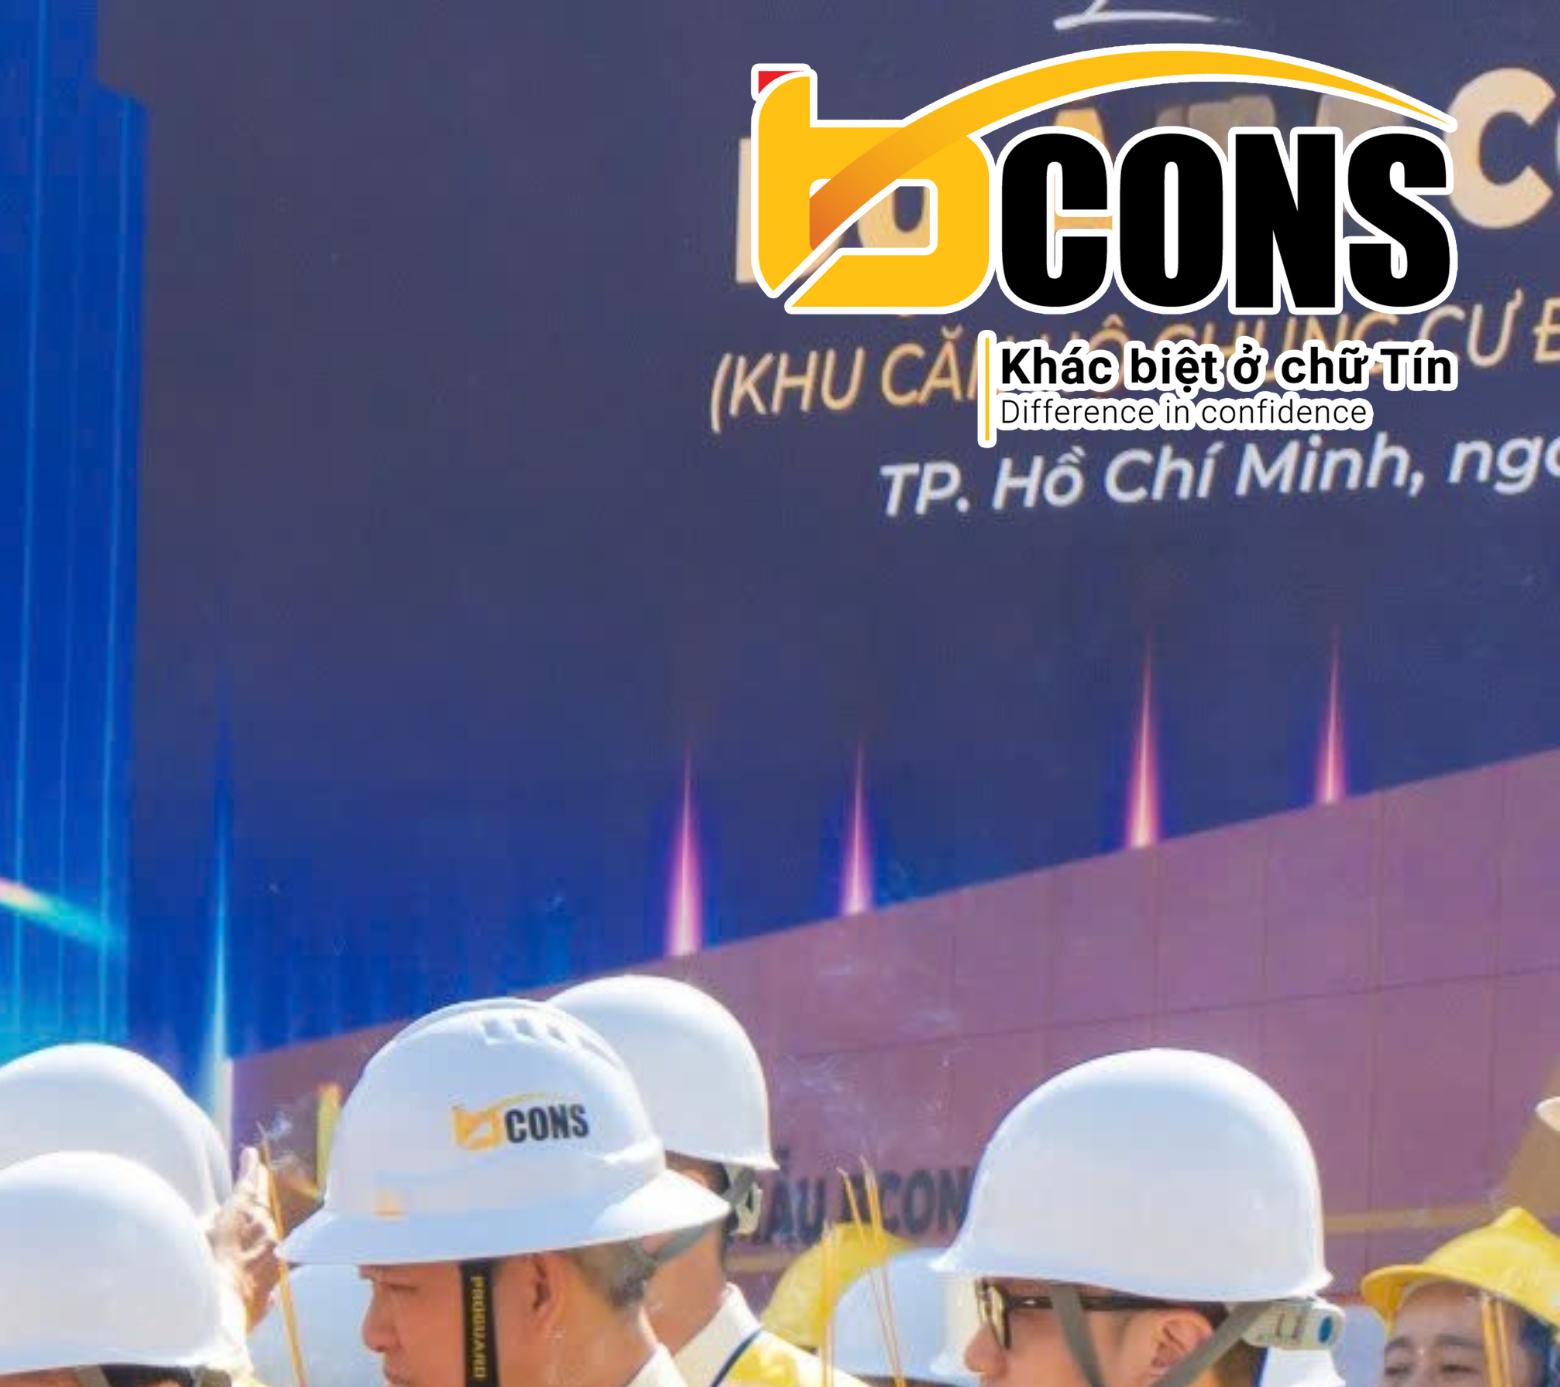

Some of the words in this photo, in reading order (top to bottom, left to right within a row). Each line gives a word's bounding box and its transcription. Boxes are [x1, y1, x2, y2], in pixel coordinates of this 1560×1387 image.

[711, 346, 866, 434] (KHU
[879, 460, 970, 518] TP.
[991, 446, 1087, 511] Hồ
[1104, 443, 1225, 504] Chí
[1234, 432, 1425, 498] Minh,
